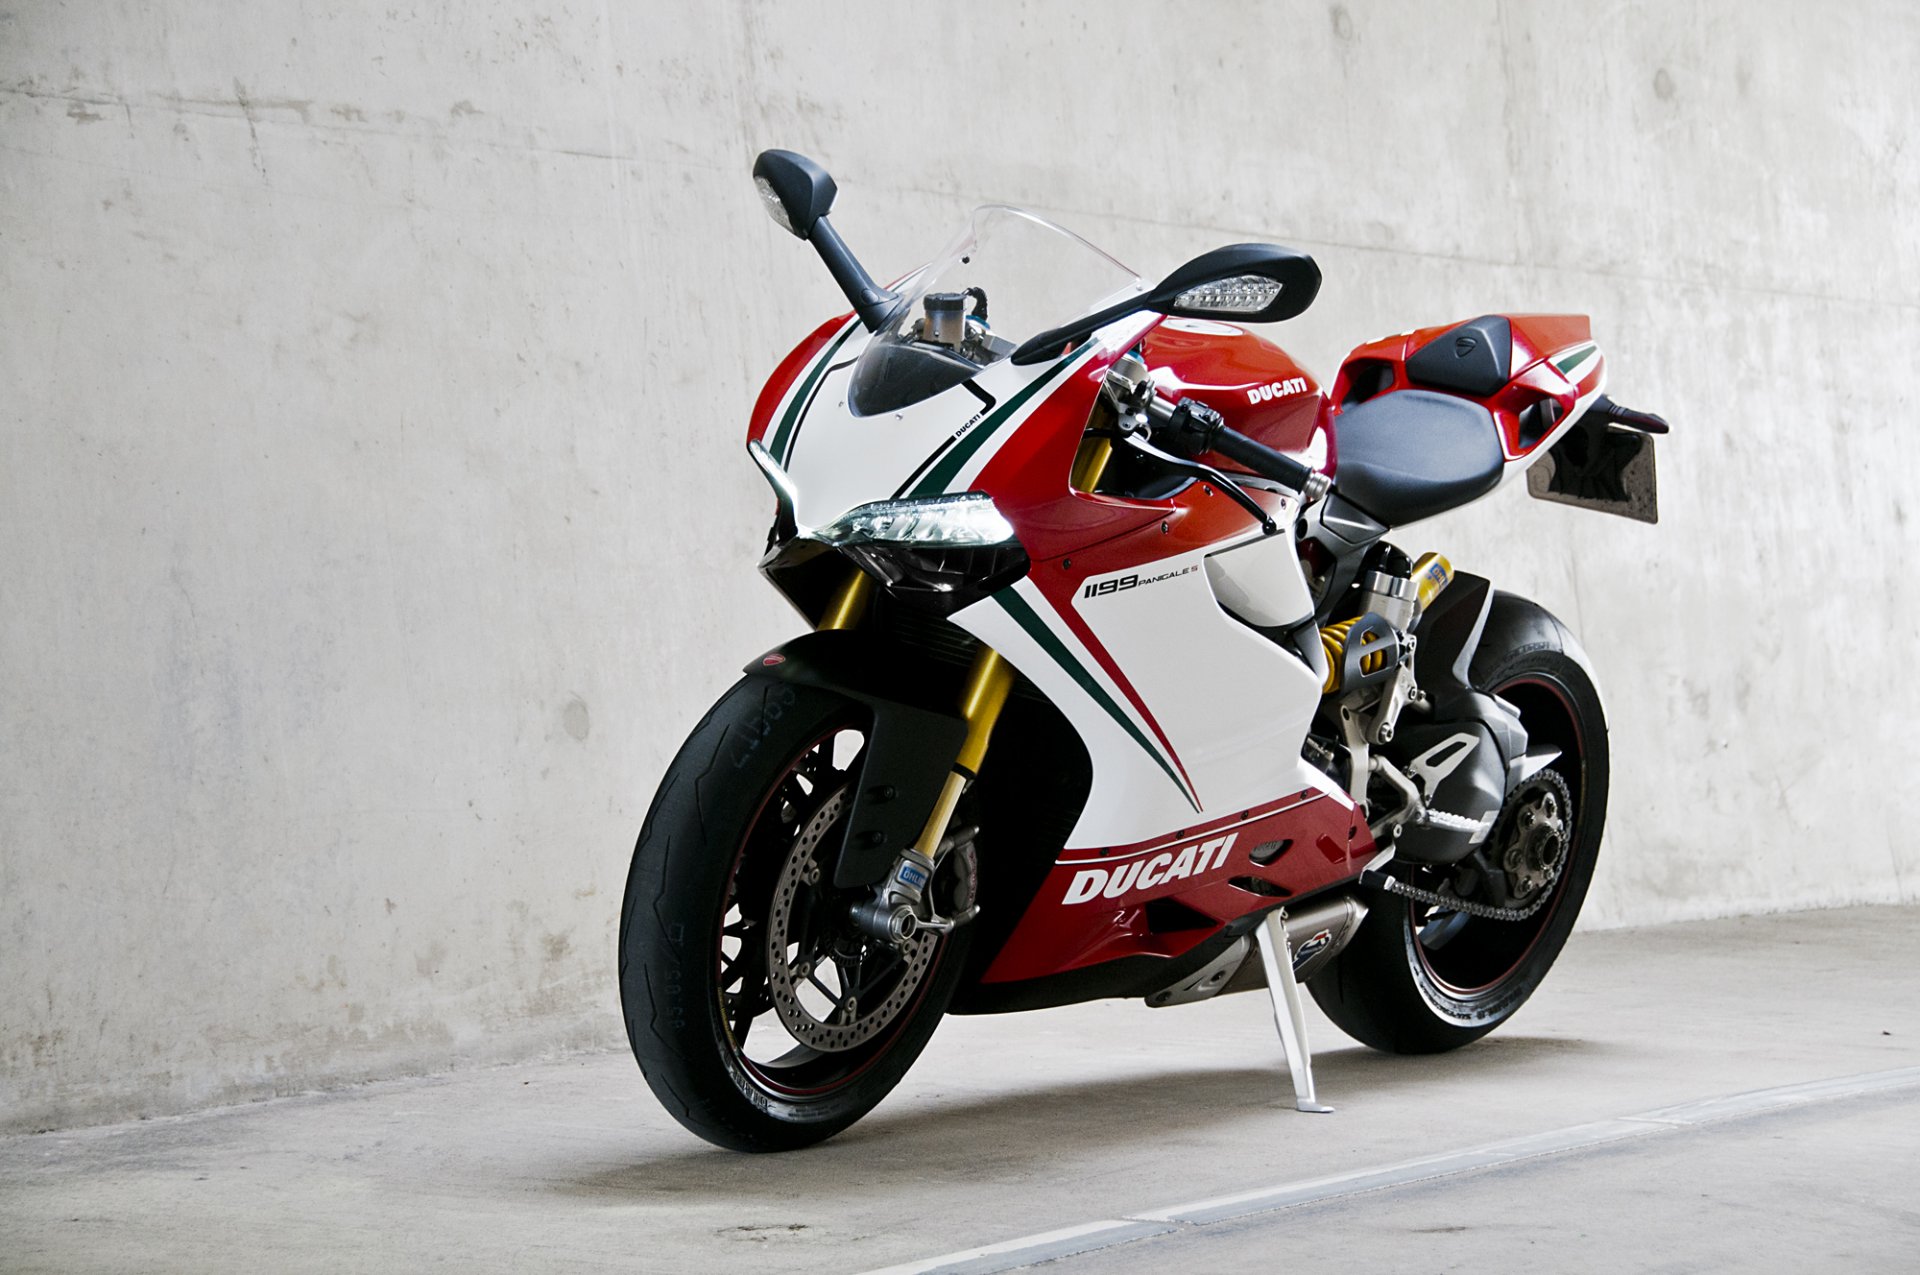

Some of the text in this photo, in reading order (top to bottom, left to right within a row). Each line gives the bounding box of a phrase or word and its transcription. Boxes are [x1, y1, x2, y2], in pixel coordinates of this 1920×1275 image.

[1247, 377, 1307, 404] DUCATI
[955, 414, 981, 437] DUCATI
[1084, 574, 1139, 598] 1199
[1138, 568, 1189, 586] PANIGALE
[1061, 832, 1239, 905] DUCATI
